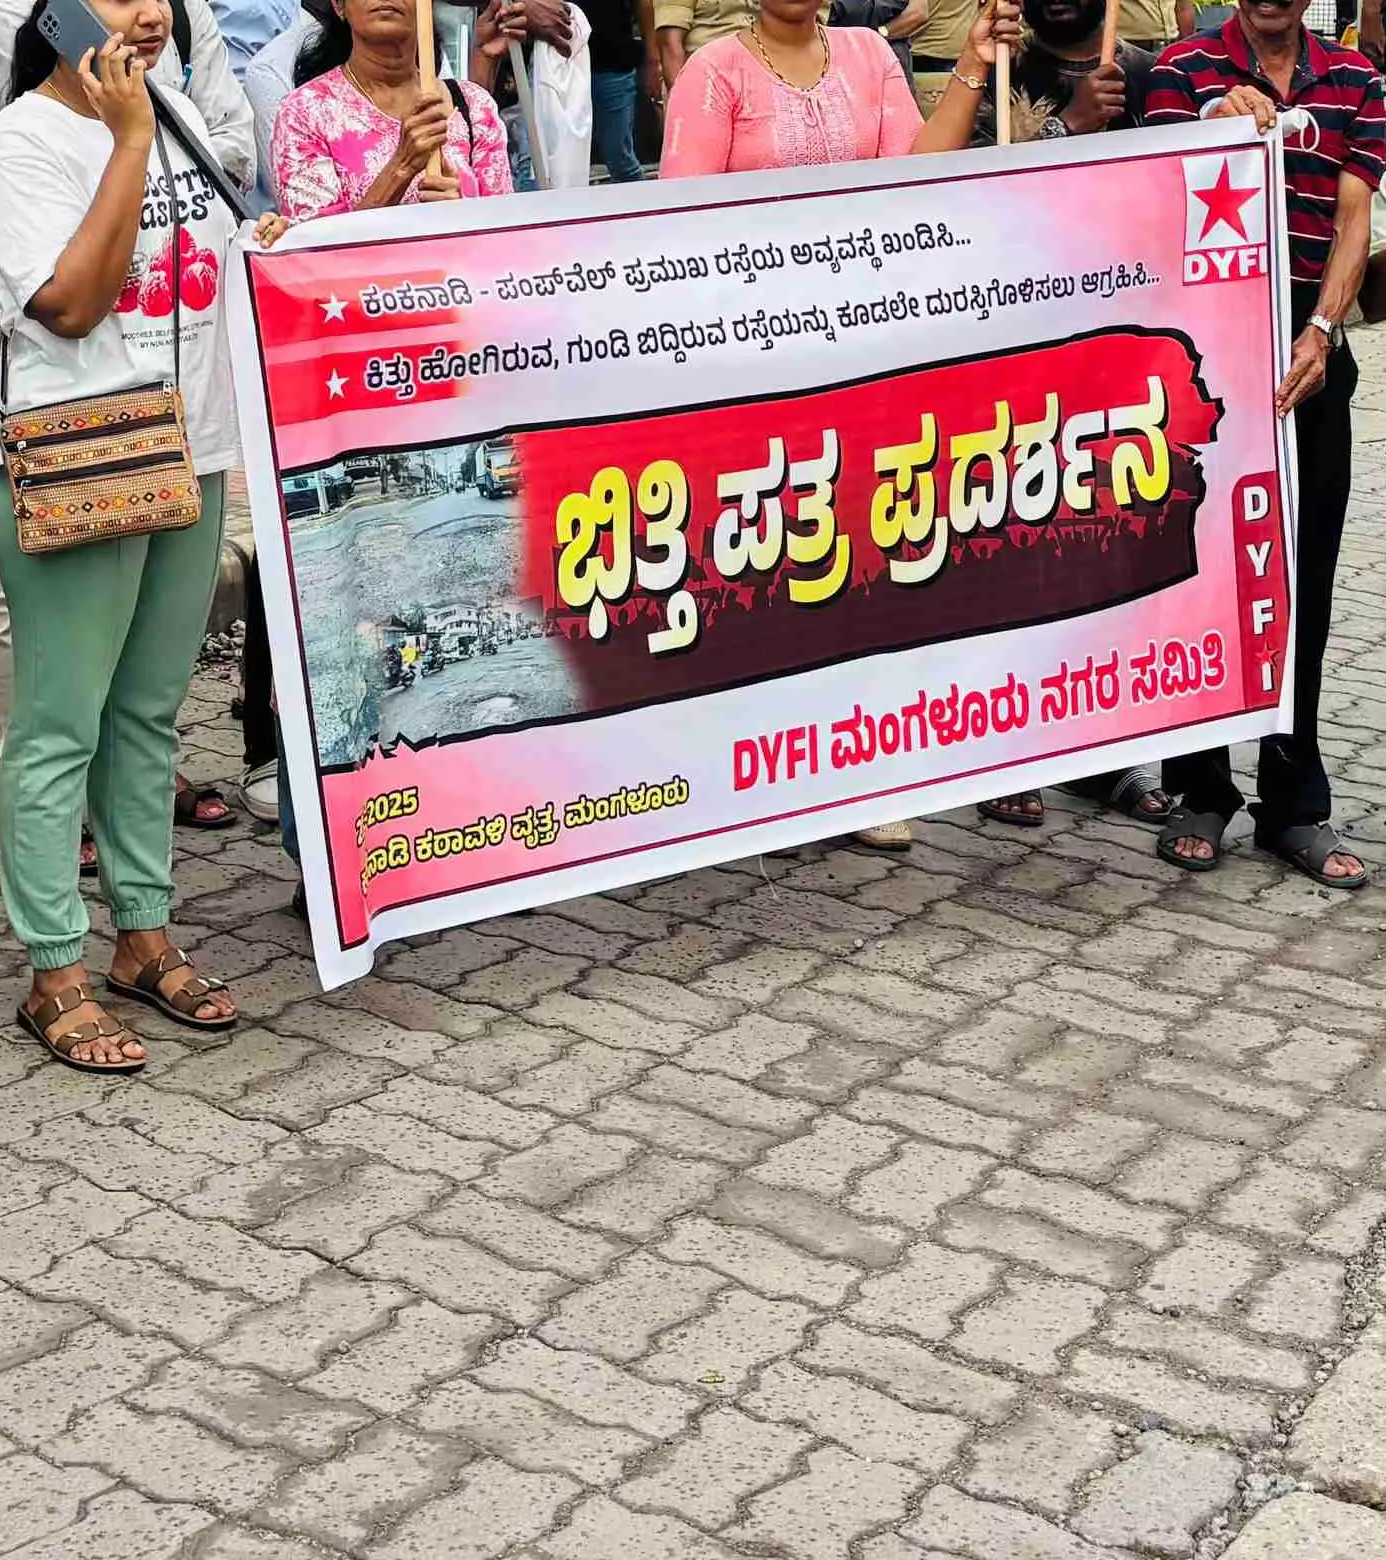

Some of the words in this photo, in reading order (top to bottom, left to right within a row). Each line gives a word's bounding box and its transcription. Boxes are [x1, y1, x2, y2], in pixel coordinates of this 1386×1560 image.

[359, 276, 473, 318] ಕಂಕನಾಡಿ
[622, 248, 708, 293] ಪ್ರಮುಖ
[714, 246, 785, 287] ರಸ್ತೆಯ
[789, 232, 883, 278] ಅವ್ಯವಸ್ಥೆ
[1182, 247, 1268, 282] DYFI
[566, 328, 631, 367] ಗುಂಡಿ
[636, 317, 726, 367] ಬಿದ್ದಿರುವ
[731, 303, 837, 353] ರಸ್ತೆಯನ್ನು
[837, 292, 921, 330] ಕೂಡಲೇ
[555, 458, 701, 655] ಭಿತ್ತಿ
[711, 428, 852, 604] ಪತ್ರ
[867, 373, 1171, 584] ಪ್ರದರ್ಶನ
[1241, 483, 1277, 692] DYFI
[733, 723, 819, 792] DYFI
[829, 672, 1029, 768] ಮಂಗಳೂರು
[1041, 647, 1120, 725] ನಗರ
[414, 815, 507, 863] ಕರಾವಳಿ
[564, 775, 690, 830] ಮಂಗಳೂರು
